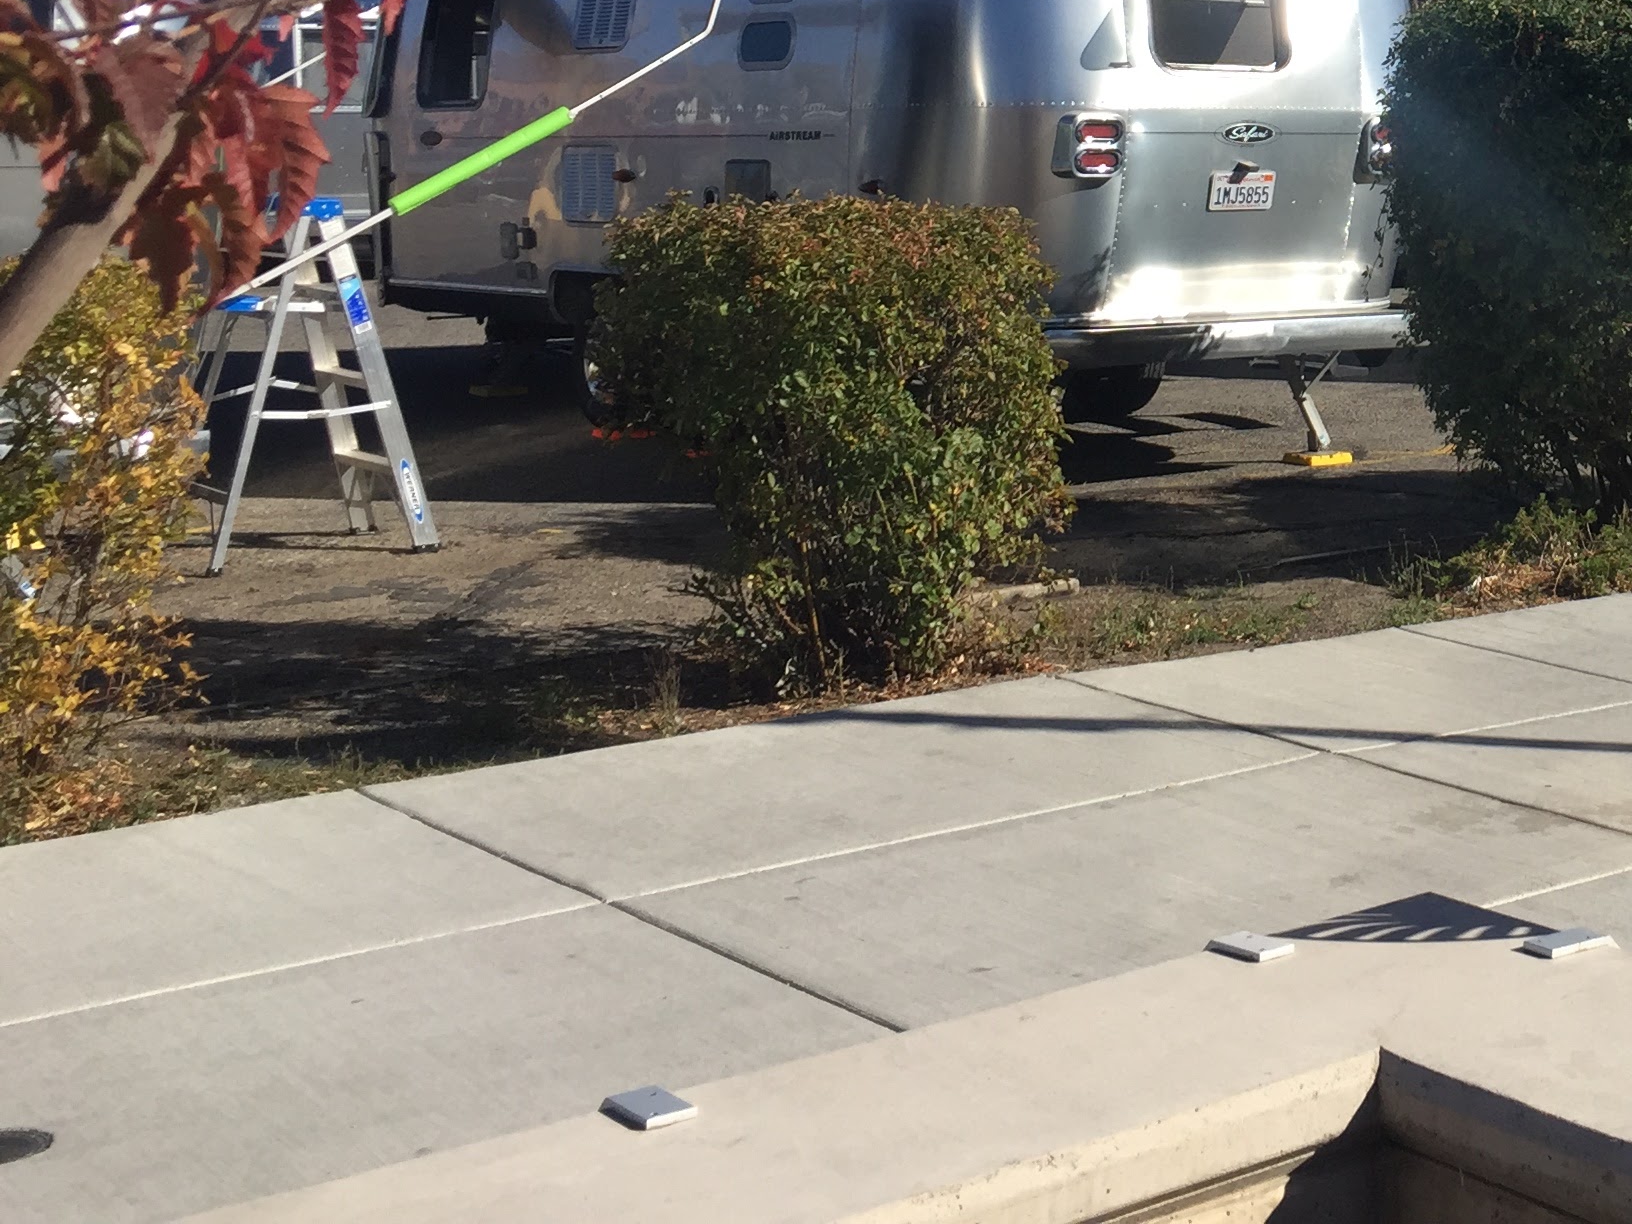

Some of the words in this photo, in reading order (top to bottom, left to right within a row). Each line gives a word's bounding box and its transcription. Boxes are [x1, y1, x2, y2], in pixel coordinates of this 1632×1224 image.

[769, 130, 821, 141] AIRSTREAM
[1228, 125, 1269, 143] Safari
[1213, 185, 1270, 206] 1MJ5855
[404, 472, 421, 511] WERNER
